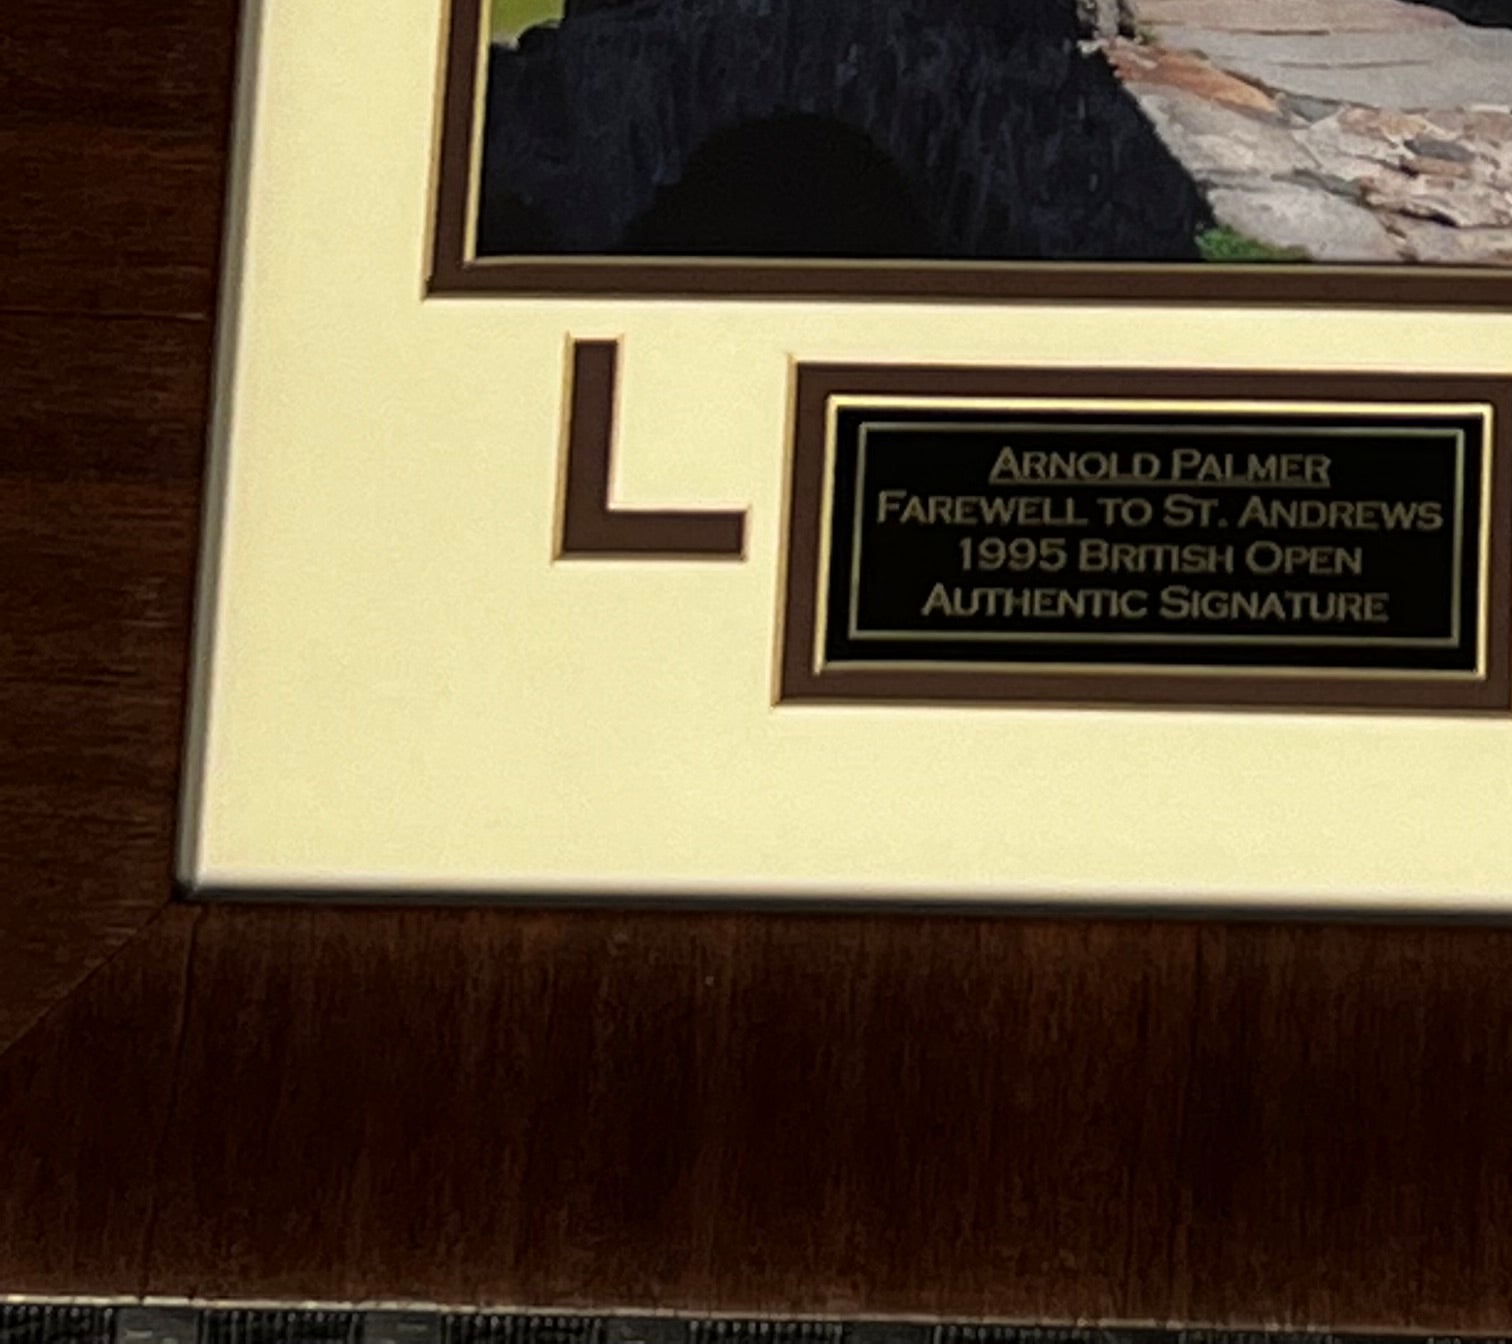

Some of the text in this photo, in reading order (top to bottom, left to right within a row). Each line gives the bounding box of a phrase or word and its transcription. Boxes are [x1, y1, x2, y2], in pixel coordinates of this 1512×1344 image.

[989, 446, 1332, 484] ARNOLD PALMER
[877, 490, 1443, 531] FAREWELL TO ST. ANDREWS
[958, 538, 1362, 576] 1995 BRITISH OPEN
[921, 583, 1390, 623] AUTHENTIC SIGNATURE
